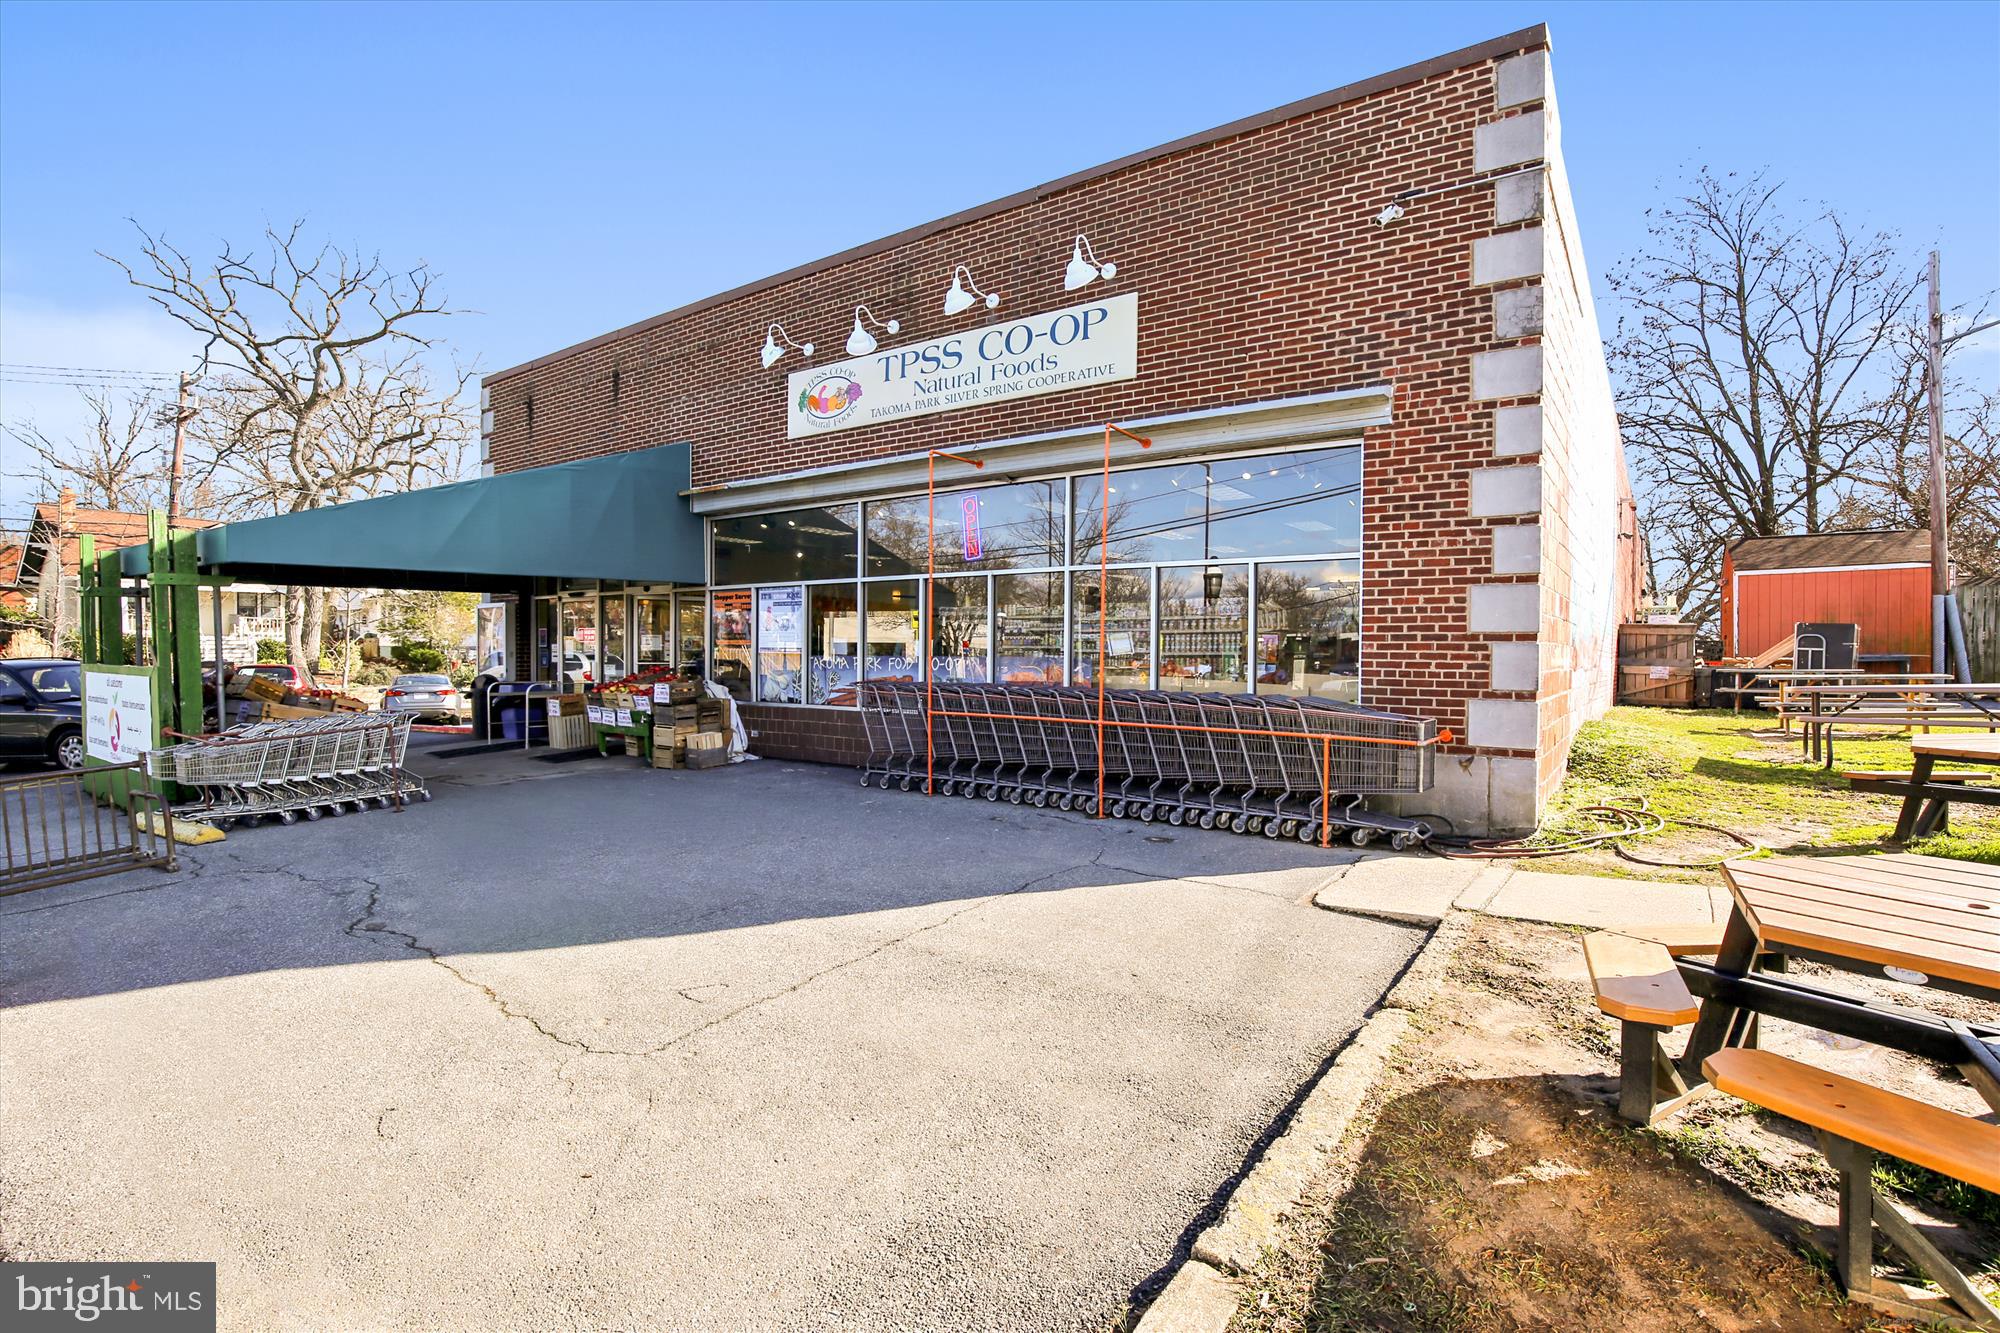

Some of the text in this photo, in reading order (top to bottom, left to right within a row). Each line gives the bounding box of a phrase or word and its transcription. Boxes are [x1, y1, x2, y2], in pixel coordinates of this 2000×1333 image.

[877, 307, 1108, 382] TPSS CO-OP
[807, 367, 857, 388] TPSS CO-OP
[870, 363, 1116, 419] TAKOMA PARK SILVER SPRING COOPERATIVE
[913, 352, 1058, 397] Natural Foods
[964, 498, 978, 557] OPEN
[853, 656, 882, 672] PRK
